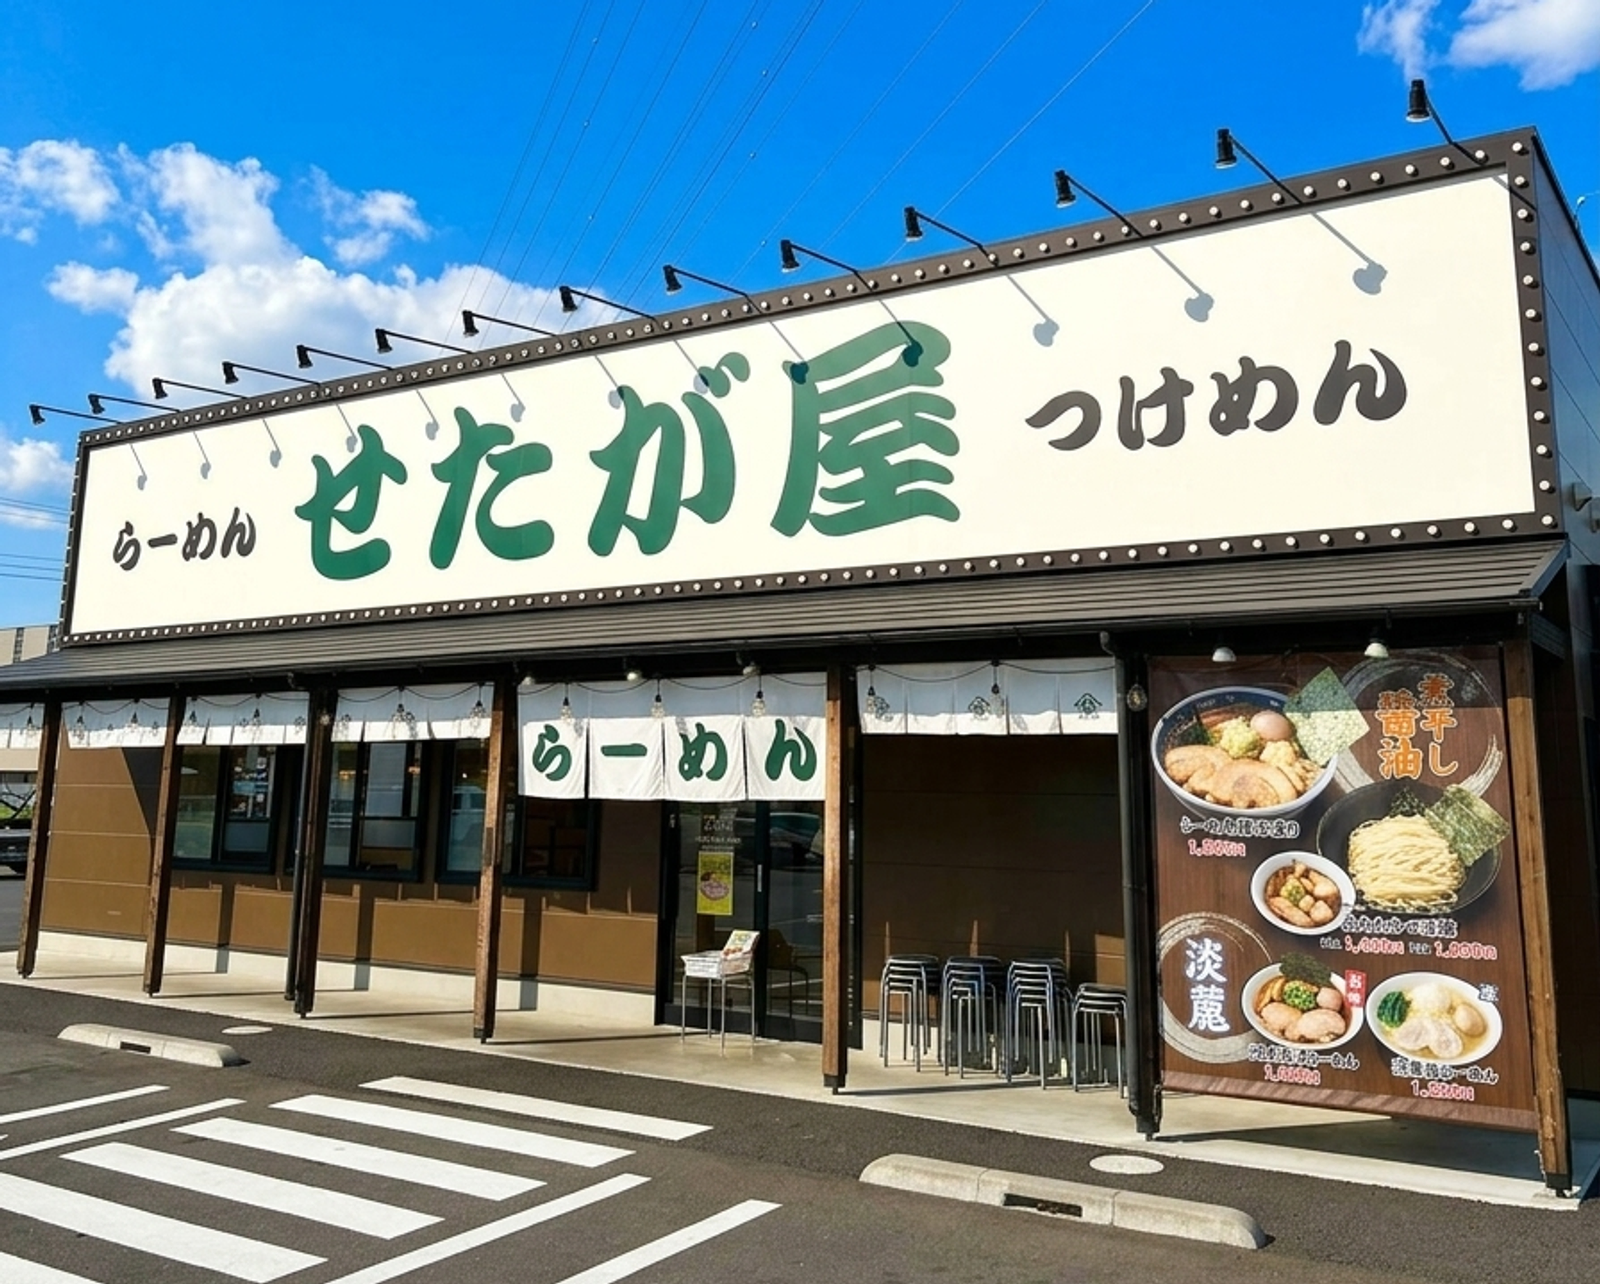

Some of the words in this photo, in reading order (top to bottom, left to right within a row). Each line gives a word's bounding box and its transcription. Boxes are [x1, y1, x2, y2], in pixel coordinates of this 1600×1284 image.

[1025, 339, 1408, 451] つけめん
[295, 320, 961, 580] せたが屋
[113, 507, 256, 571] らーめん
[532, 718, 818, 782] らーめん
